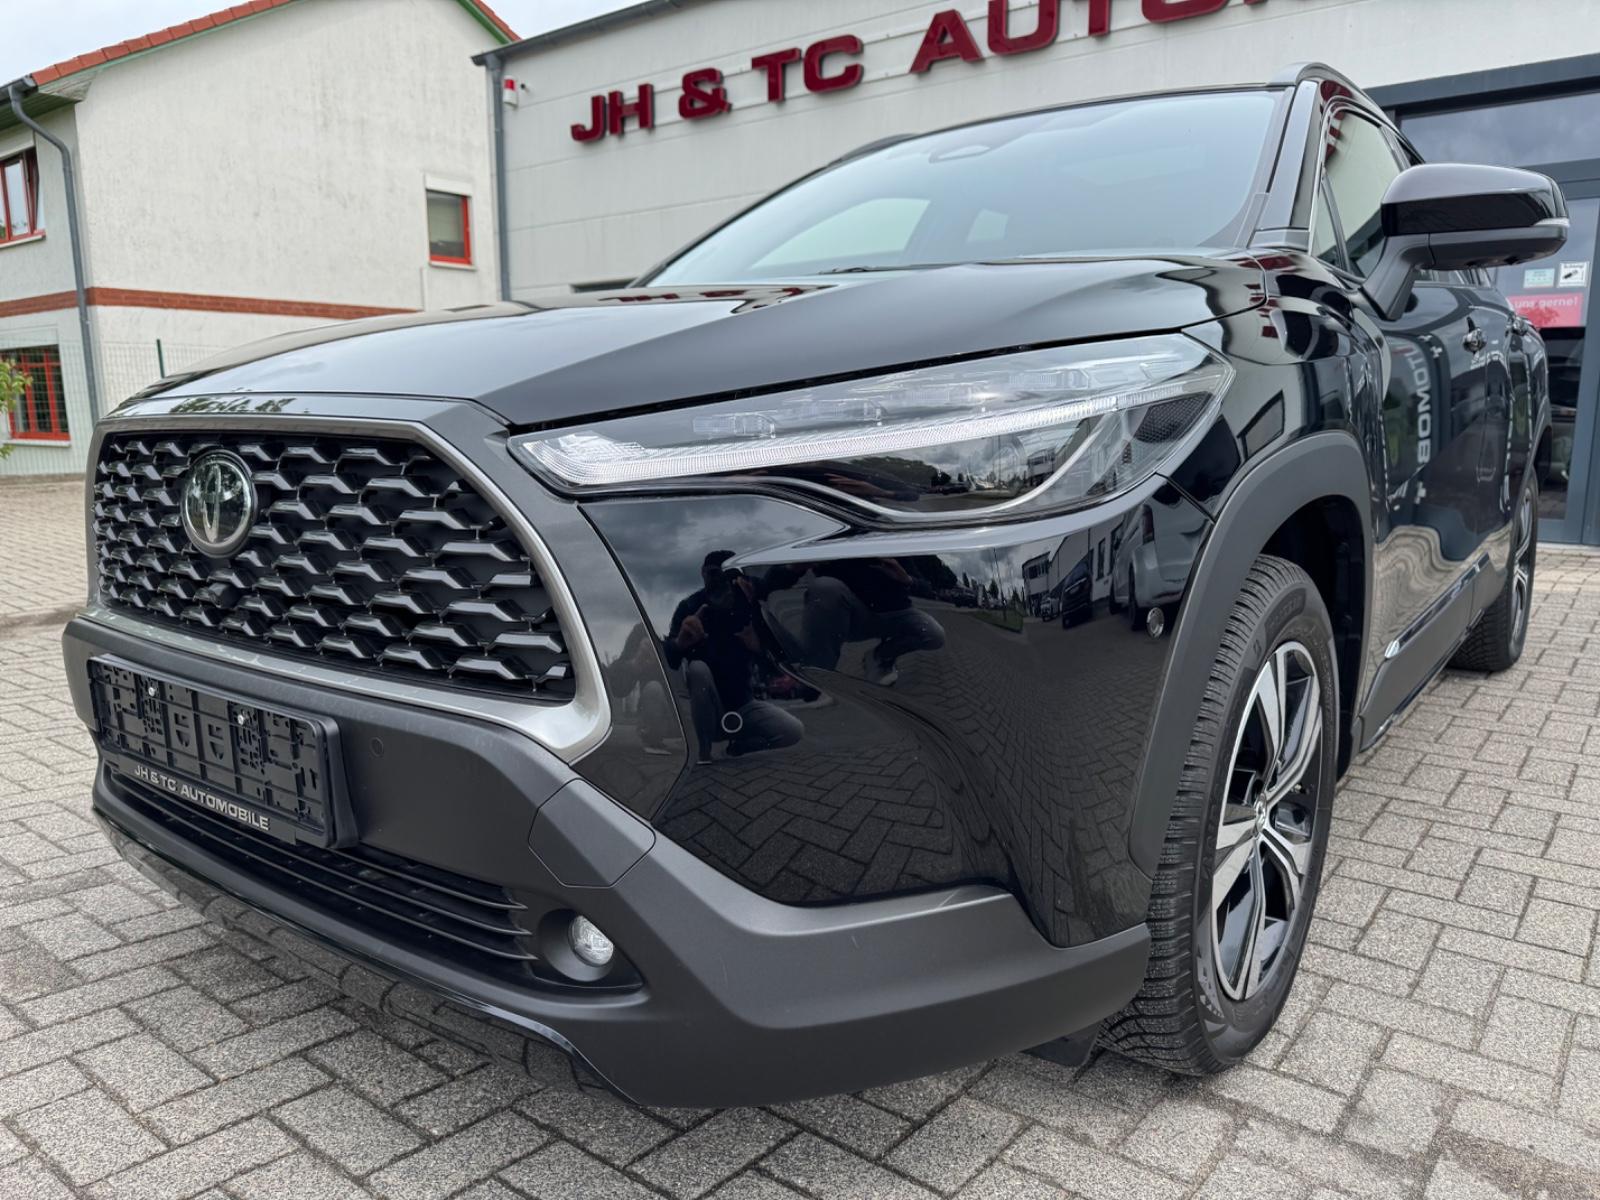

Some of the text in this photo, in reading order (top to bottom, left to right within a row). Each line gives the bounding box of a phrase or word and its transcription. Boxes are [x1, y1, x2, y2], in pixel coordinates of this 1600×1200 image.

[571, 0, 1266, 142] JH & TC AUT
[135, 765, 269, 830] JH & TC AUTOMOBILE
